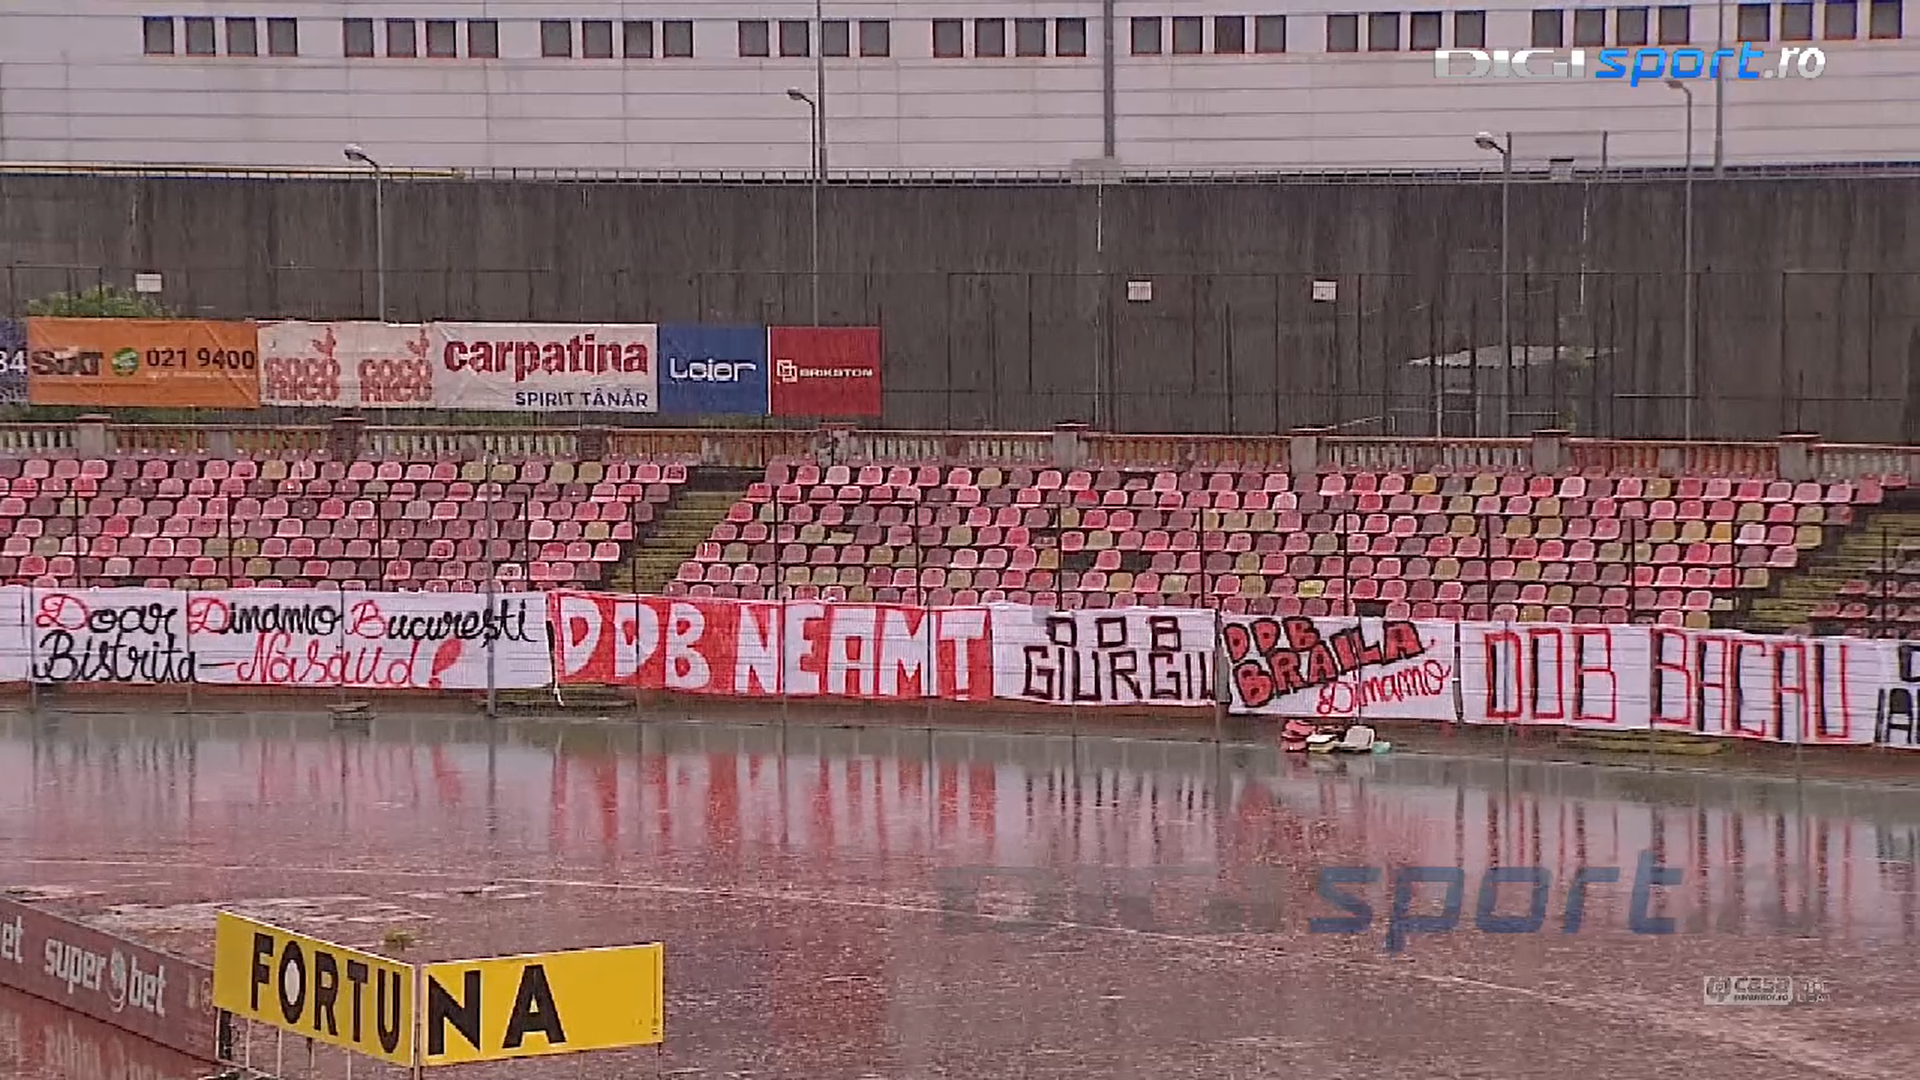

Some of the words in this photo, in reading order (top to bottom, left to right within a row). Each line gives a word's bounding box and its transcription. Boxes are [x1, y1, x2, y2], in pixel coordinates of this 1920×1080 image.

[147, 348, 187, 369] 021
[197, 347, 255, 370] 9400
[444, 333, 649, 383] carpatina
[515, 391, 574, 407] SPIRIT
[187, 597, 343, 635] Dinamo
